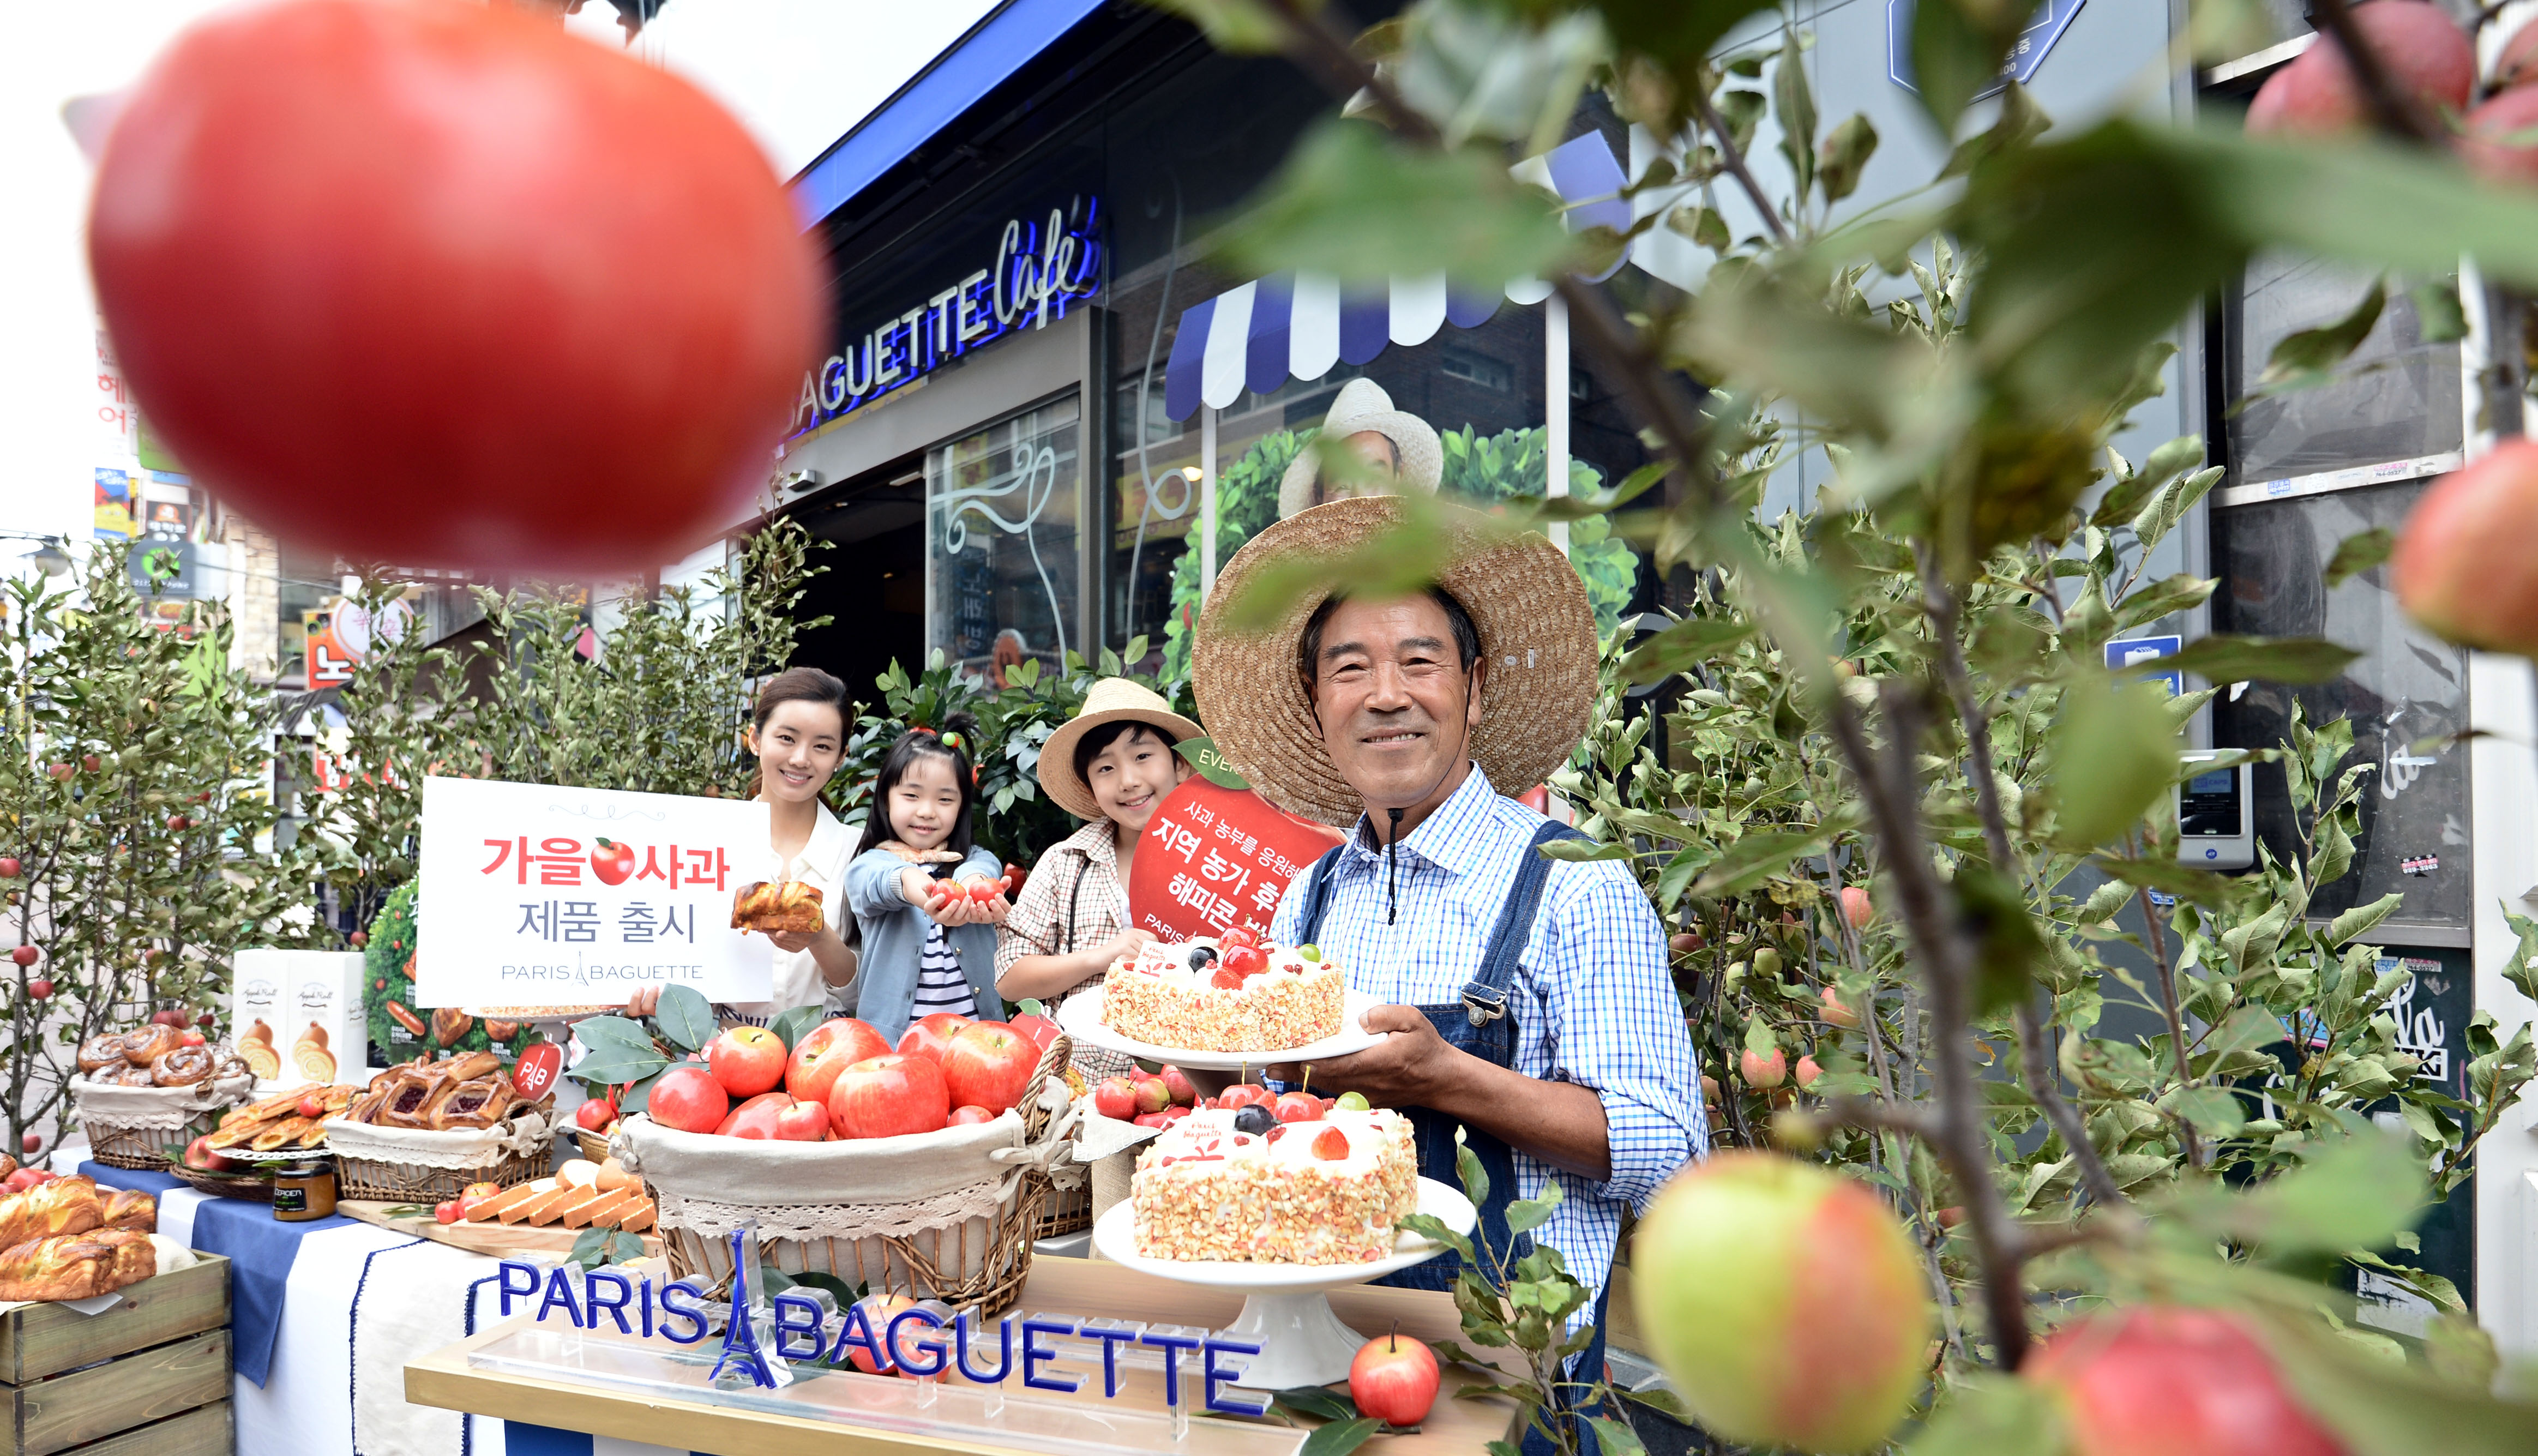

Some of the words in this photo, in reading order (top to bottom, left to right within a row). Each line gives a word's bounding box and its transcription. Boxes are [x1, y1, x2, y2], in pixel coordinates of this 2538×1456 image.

[785, 268, 988, 434] AGUETTE
[1184, 801, 1214, 829] 사과
[1214, 818, 1259, 857] 농부를
[480, 837, 587, 887] 가을
[635, 844, 731, 892] 사과
[1152, 817, 1202, 864] 지역
[1200, 847, 1252, 896] 농가
[1250, 880, 1282, 913] 후
[516, 900, 602, 943] 제품
[618, 901, 695, 944] 출시
[1144, 913, 1186, 944] PARIS
[1168, 872, 1238, 933] 해피콘
[502, 966, 570, 980] PARIS
[591, 965, 703, 980] BAGUETTE
[500, 1260, 709, 1344] PARIS
[774, 1295, 1261, 1416] BAGUETTE
